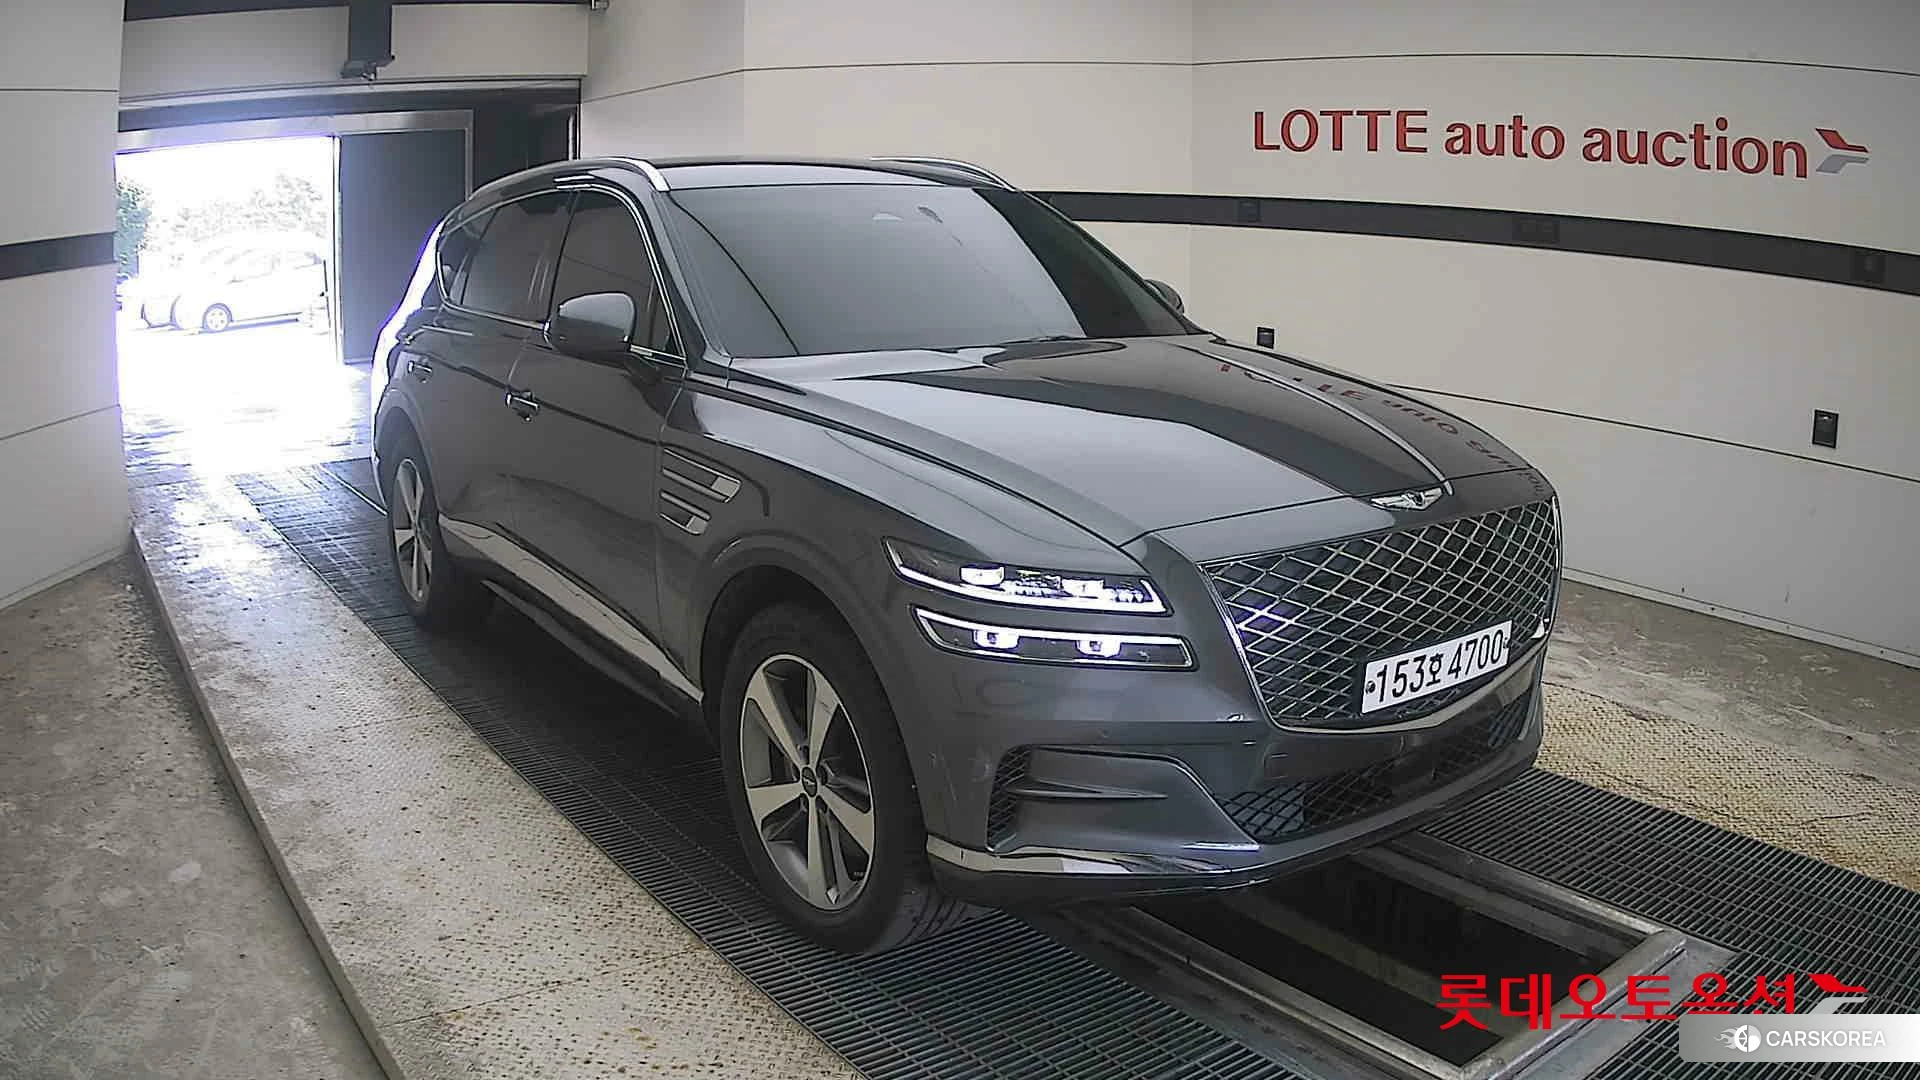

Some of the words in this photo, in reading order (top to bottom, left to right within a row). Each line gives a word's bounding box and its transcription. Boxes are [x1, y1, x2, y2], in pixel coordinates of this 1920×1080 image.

[1252, 109, 1428, 153] LOTTE
[1444, 114, 1566, 160] auto
[1583, 116, 1809, 178] auction
[1448, 629, 1504, 680] 4700
